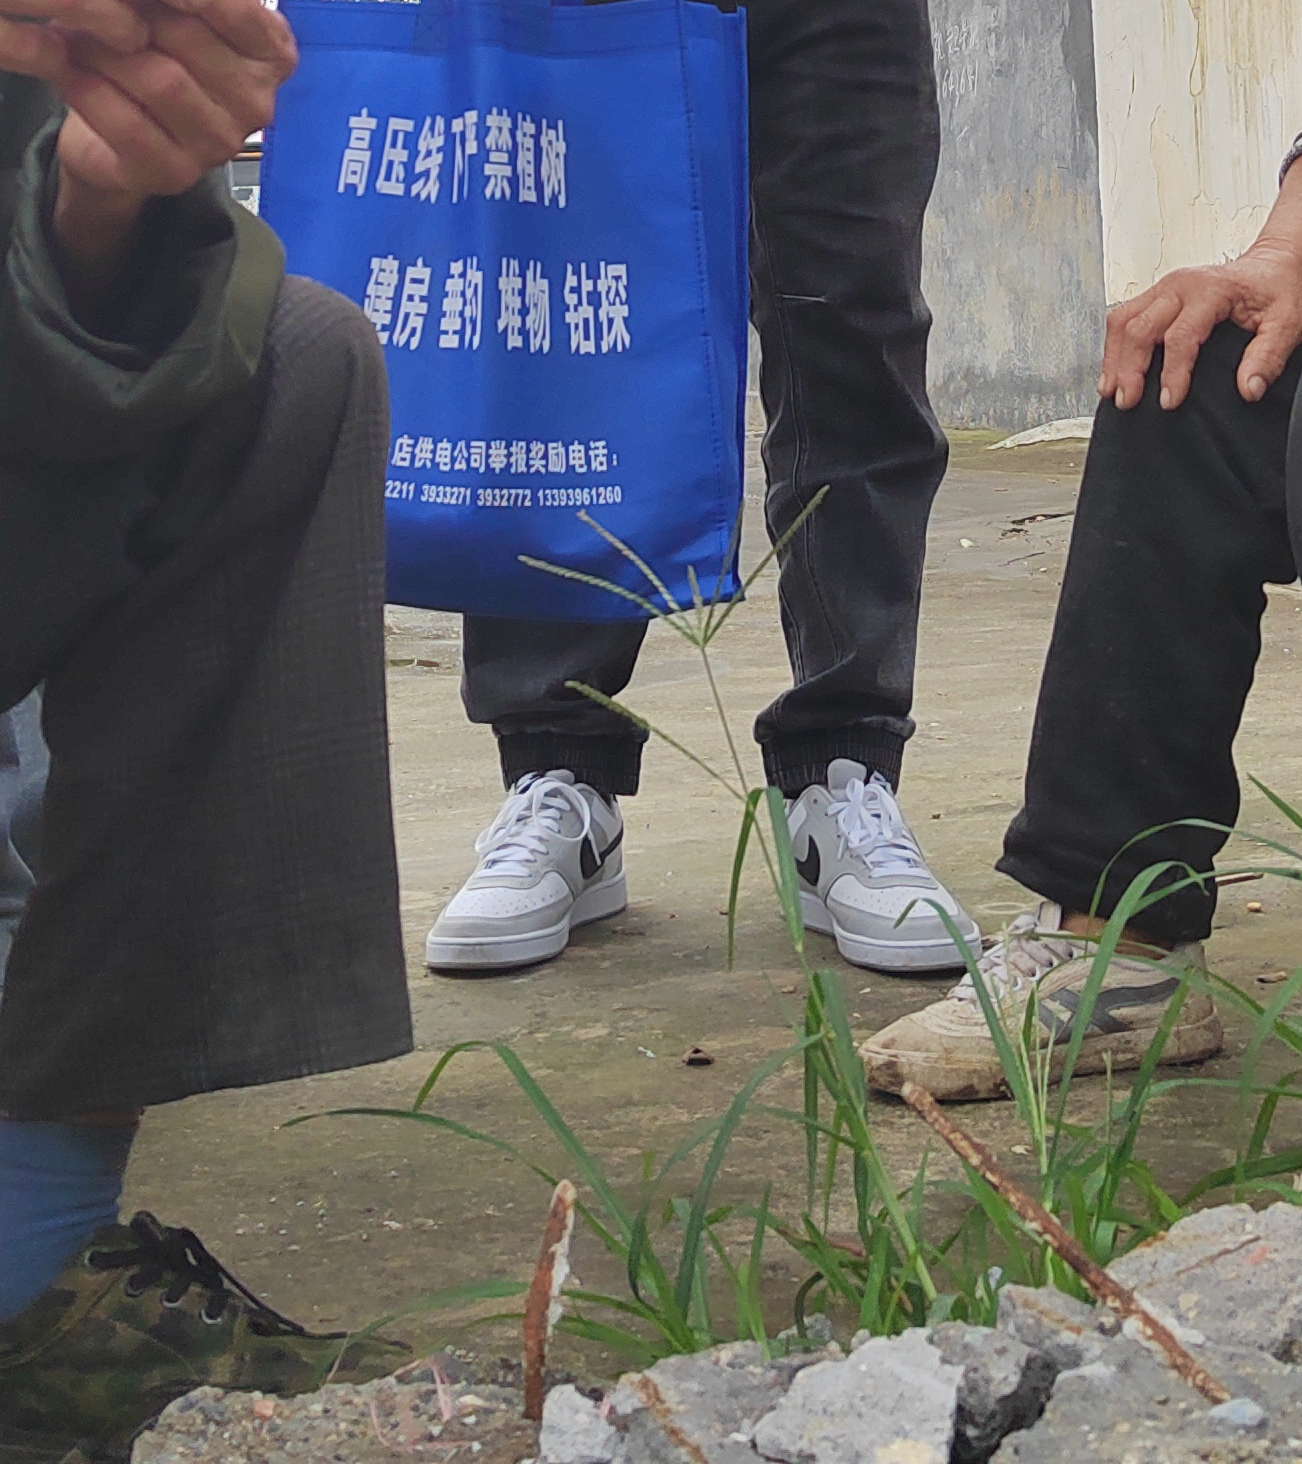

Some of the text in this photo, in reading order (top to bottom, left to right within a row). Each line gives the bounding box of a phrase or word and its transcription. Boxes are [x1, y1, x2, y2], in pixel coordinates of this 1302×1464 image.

[337, 107, 567, 209] 高压线严禁植树
[363, 254, 432, 351] 建房
[497, 257, 550, 355] 堆物
[563, 260, 631, 355] 钻探
[420, 484, 472, 506] 3933271
[476, 487, 533, 507] 3932772
